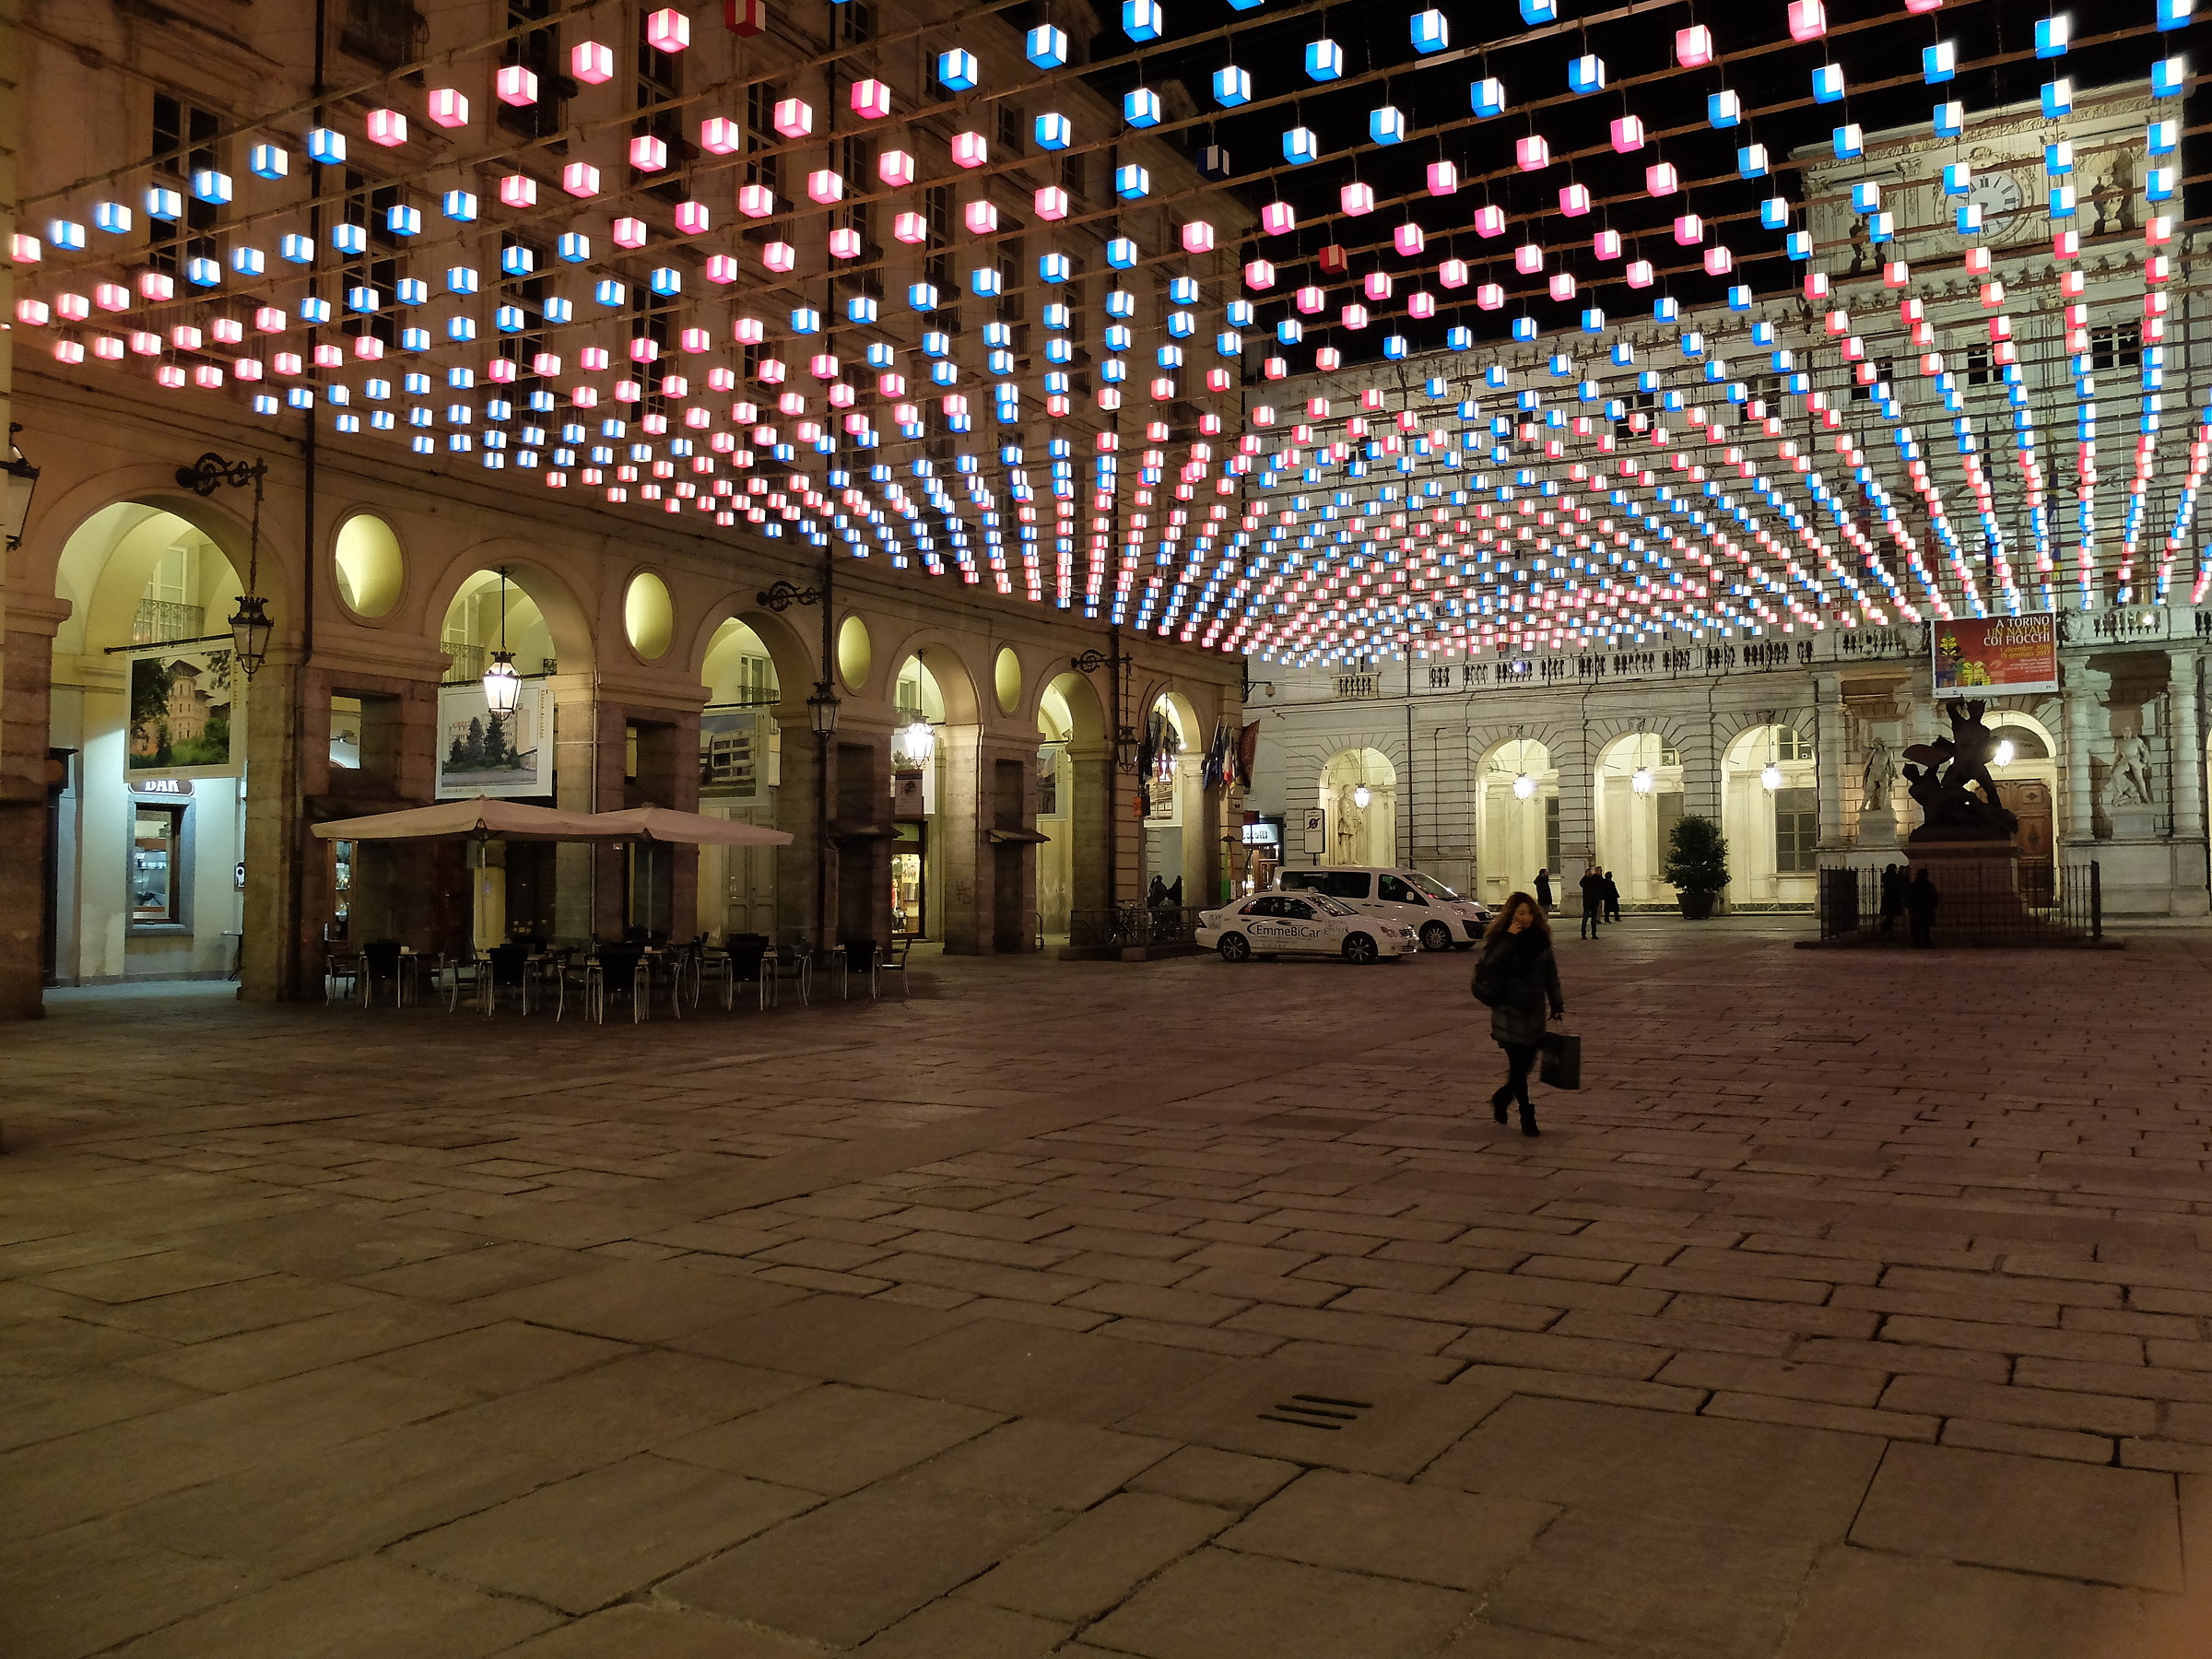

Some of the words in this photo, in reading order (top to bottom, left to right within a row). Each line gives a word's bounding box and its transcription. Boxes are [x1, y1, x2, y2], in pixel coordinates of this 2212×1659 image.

[1995, 619, 2004, 629] A
[2007, 616, 2050, 628] TORINO
[1986, 628, 2003, 637] UN
[2006, 624, 2050, 636] NATALE
[1983, 636, 2002, 646] COI
[2006, 631, 2050, 645] FIOCCHI
[1256, 924, 1322, 938] EmmeBiCar
